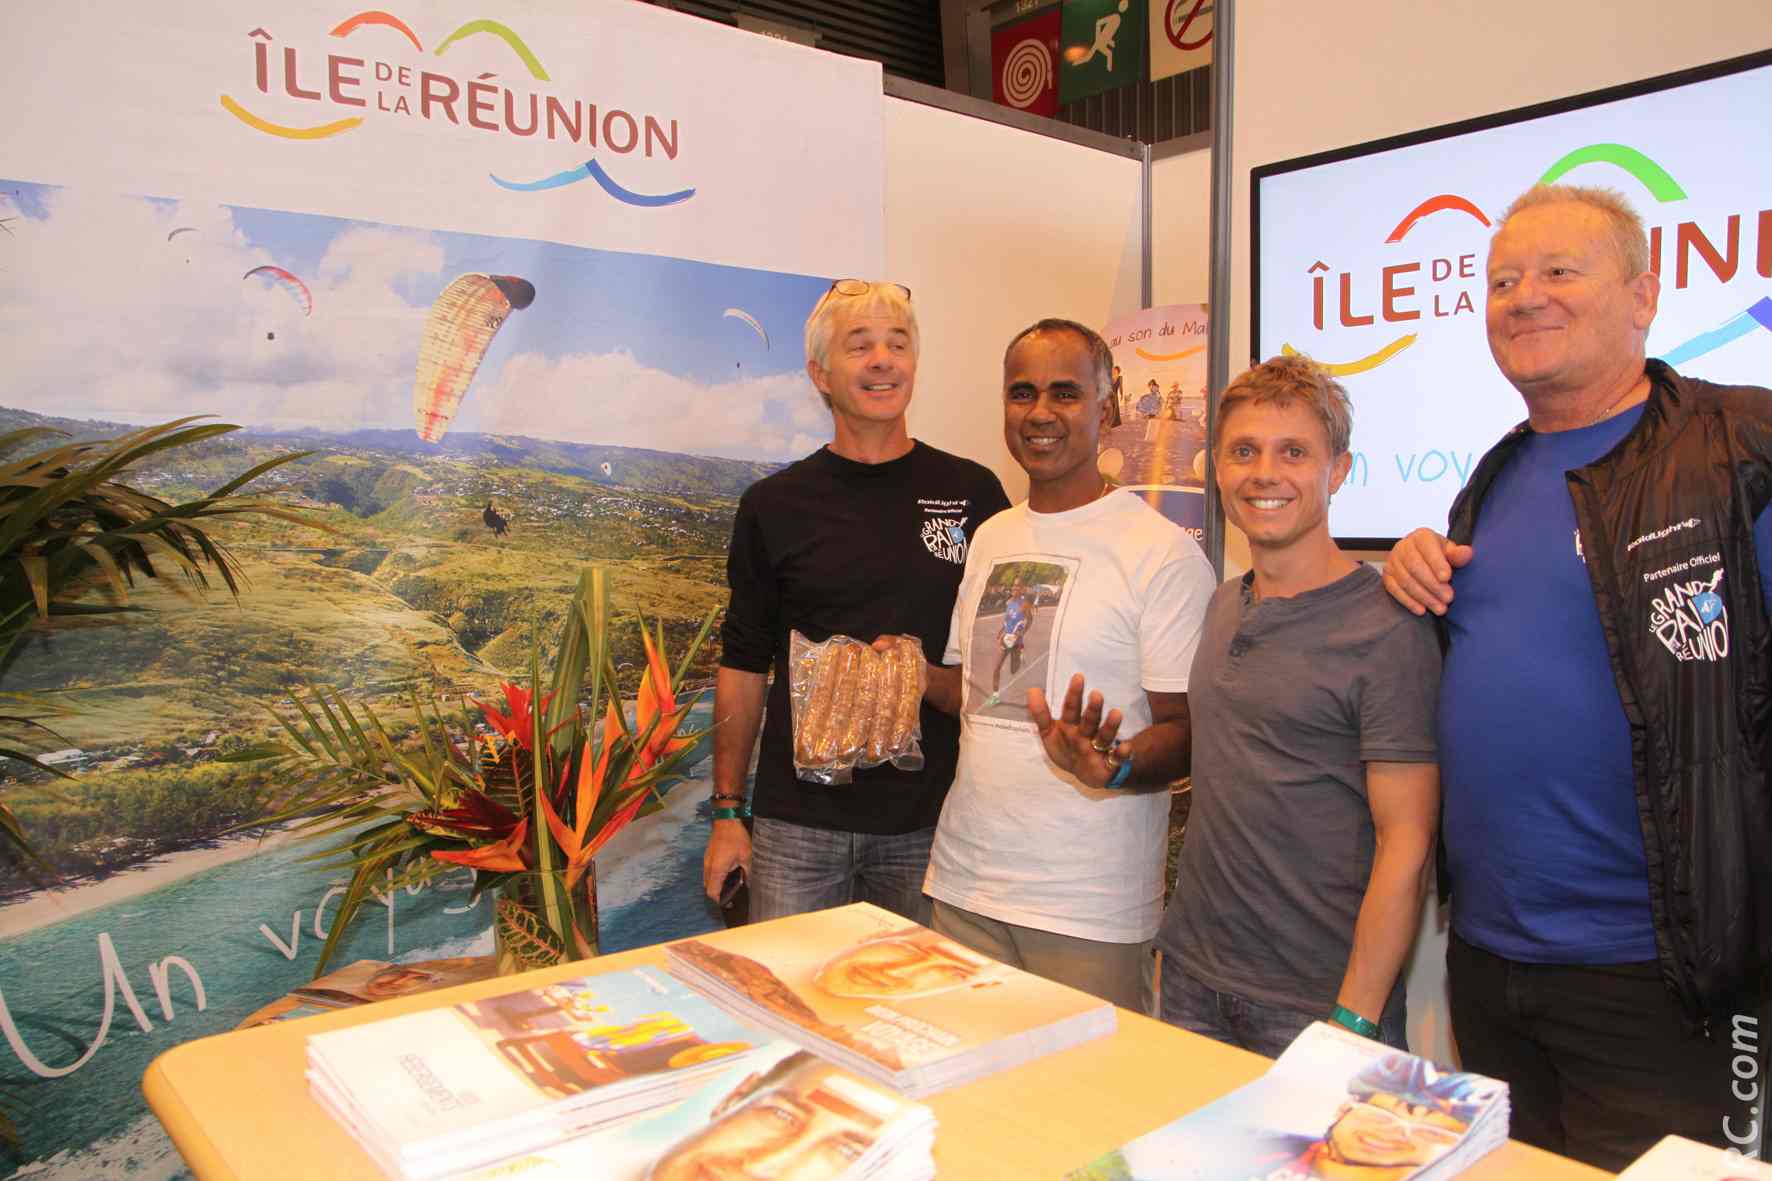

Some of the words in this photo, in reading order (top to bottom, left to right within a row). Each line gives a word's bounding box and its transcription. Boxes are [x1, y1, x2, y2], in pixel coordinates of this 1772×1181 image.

[248, 28, 367, 107] ÎLE
[375, 61, 411, 87] DE
[378, 91, 411, 116] LA
[420, 72, 680, 161] RÉUNION
[1432, 254, 1476, 282] DE
[1307, 251, 1421, 331] ÎLE
[1434, 291, 1475, 318] LA
[1127, 327, 1152, 342] son
[1158, 321, 1176, 337] du
[1643, 561, 1689, 583] Partenaire
[1689, 551, 1721, 568] Officiel
[1651, 581, 1703, 625] GRAND
[0, 932, 207, 1078] Un
